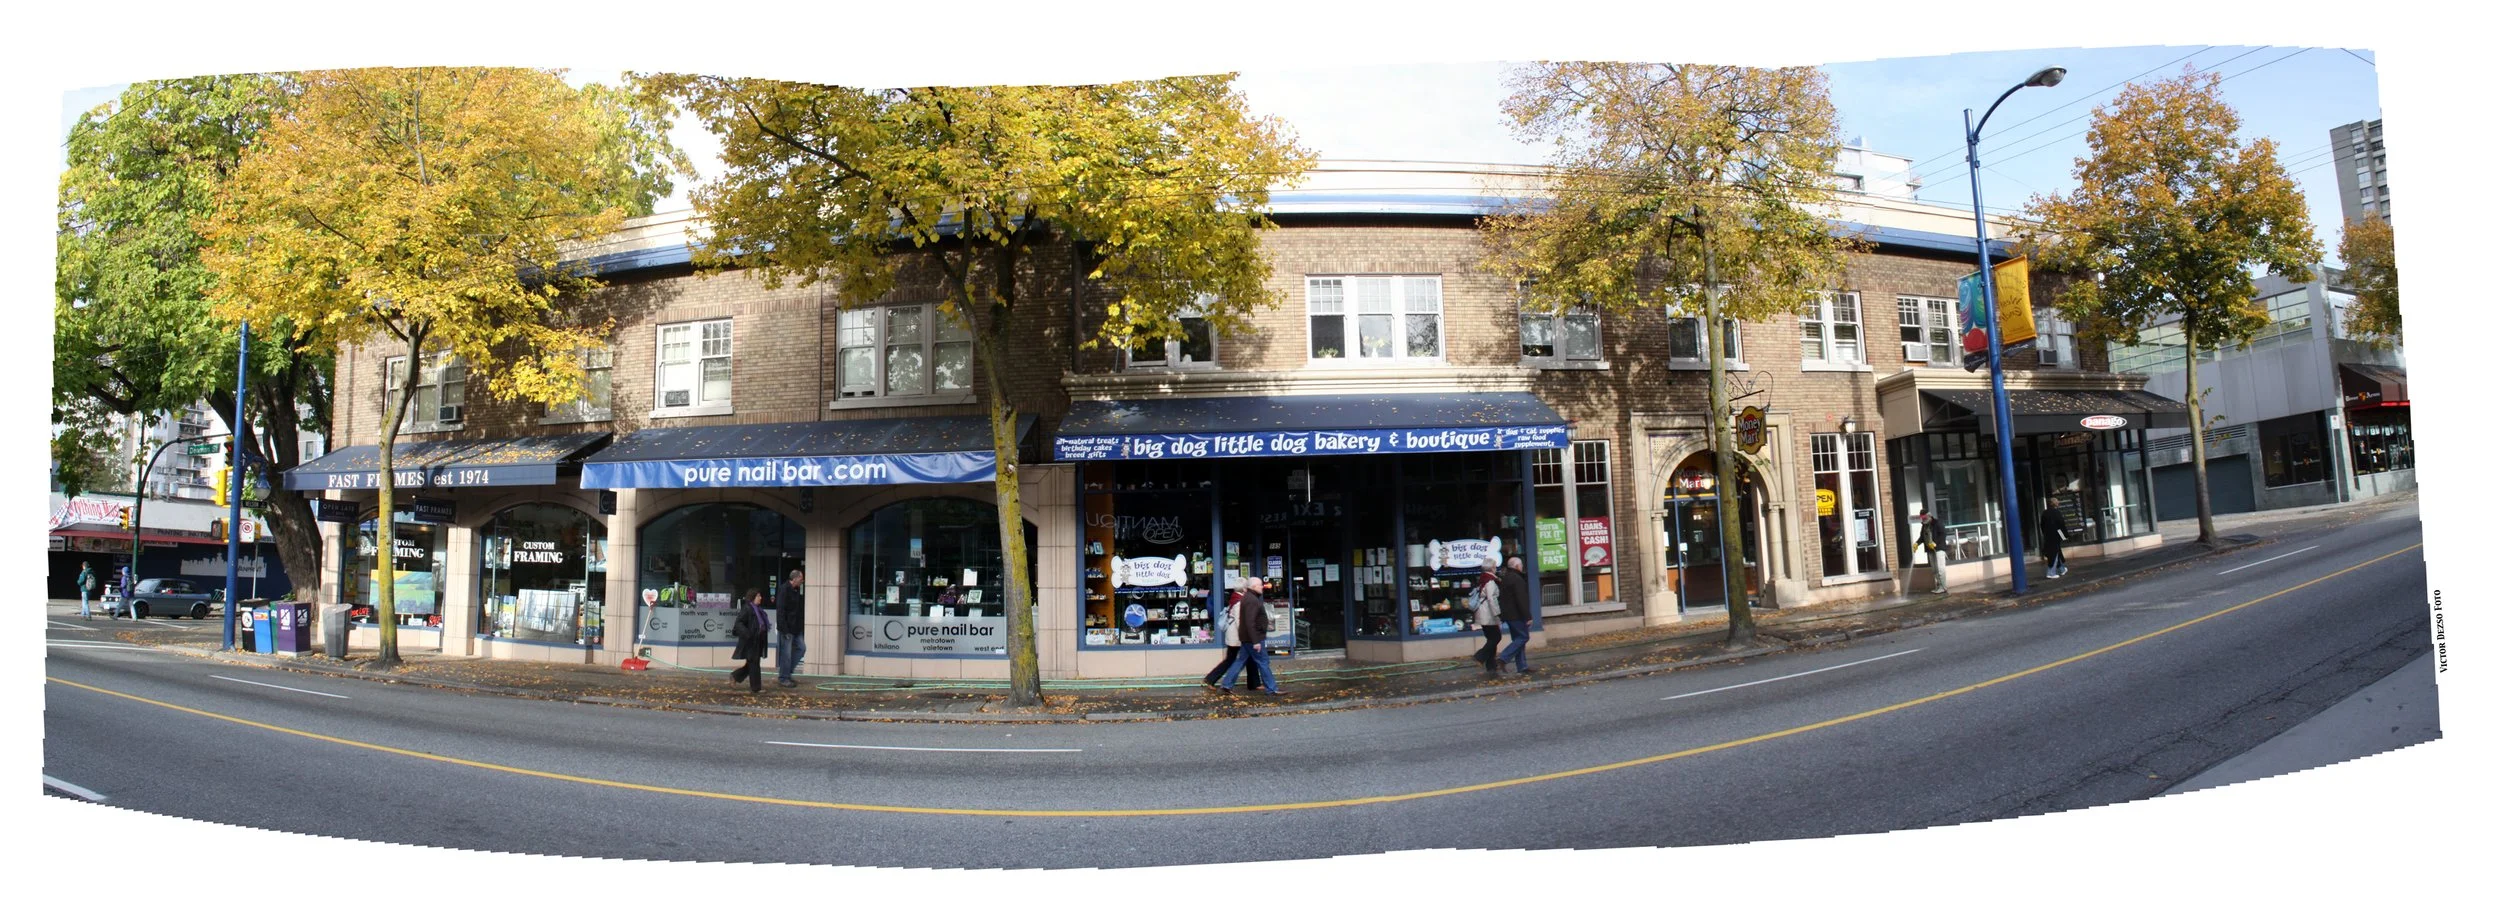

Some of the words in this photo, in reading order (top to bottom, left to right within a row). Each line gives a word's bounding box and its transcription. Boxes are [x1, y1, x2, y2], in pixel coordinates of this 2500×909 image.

[1740, 418, 1761, 432] Money
[2085, 416, 2123, 427] panago
[1505, 428, 1519, 436] dog
[1097, 436, 1119, 444] treats
[1741, 432, 1759, 444] Mart
[1061, 444, 1092, 452] birthday
[1134, 438, 1165, 458] big
[1171, 437, 1209, 457] dog
[1214, 434, 1264, 454] little
[1270, 433, 1308, 453] dog
[1315, 432, 1381, 452] bakery
[1389, 432, 1399, 447] &
[1406, 431, 1490, 449] boutique
[1514, 440, 1555, 449] supplements
[1087, 451, 1106, 459] gifts
[684, 465, 732, 486] pure
[738, 461, 776, 482] nail
[783, 461, 821, 480] bar
[827, 463, 887, 480] .com
[328, 474, 360, 488] FAST
[367, 471, 425, 487] FMES
[434, 472, 453, 485] est
[459, 470, 489, 485] 1974
[1679, 478, 1706, 489] Mart
[1816, 494, 1833, 502] PEN
[415, 504, 429, 513] FAST
[1146, 527, 1183, 539] OPEN
[1584, 535, 1609, 545] CASH!
[523, 541, 555, 550] CUSTOM
[1452, 543, 1466, 552] big
[1470, 542, 1488, 552] dog
[371, 547, 424, 559] FMING
[513, 551, 563, 563] FRAMING
[1453, 552, 1471, 560] little
[1134, 561, 1149, 570] big
[1153, 560, 1172, 570] dog
[1543, 556, 1564, 565] FAST
[1136, 570, 1154, 578] little
[1156, 571, 1170, 579] dog
[907, 625, 939, 638] pure
[941, 624, 967, 636] nail
[970, 623, 994, 636] bar
